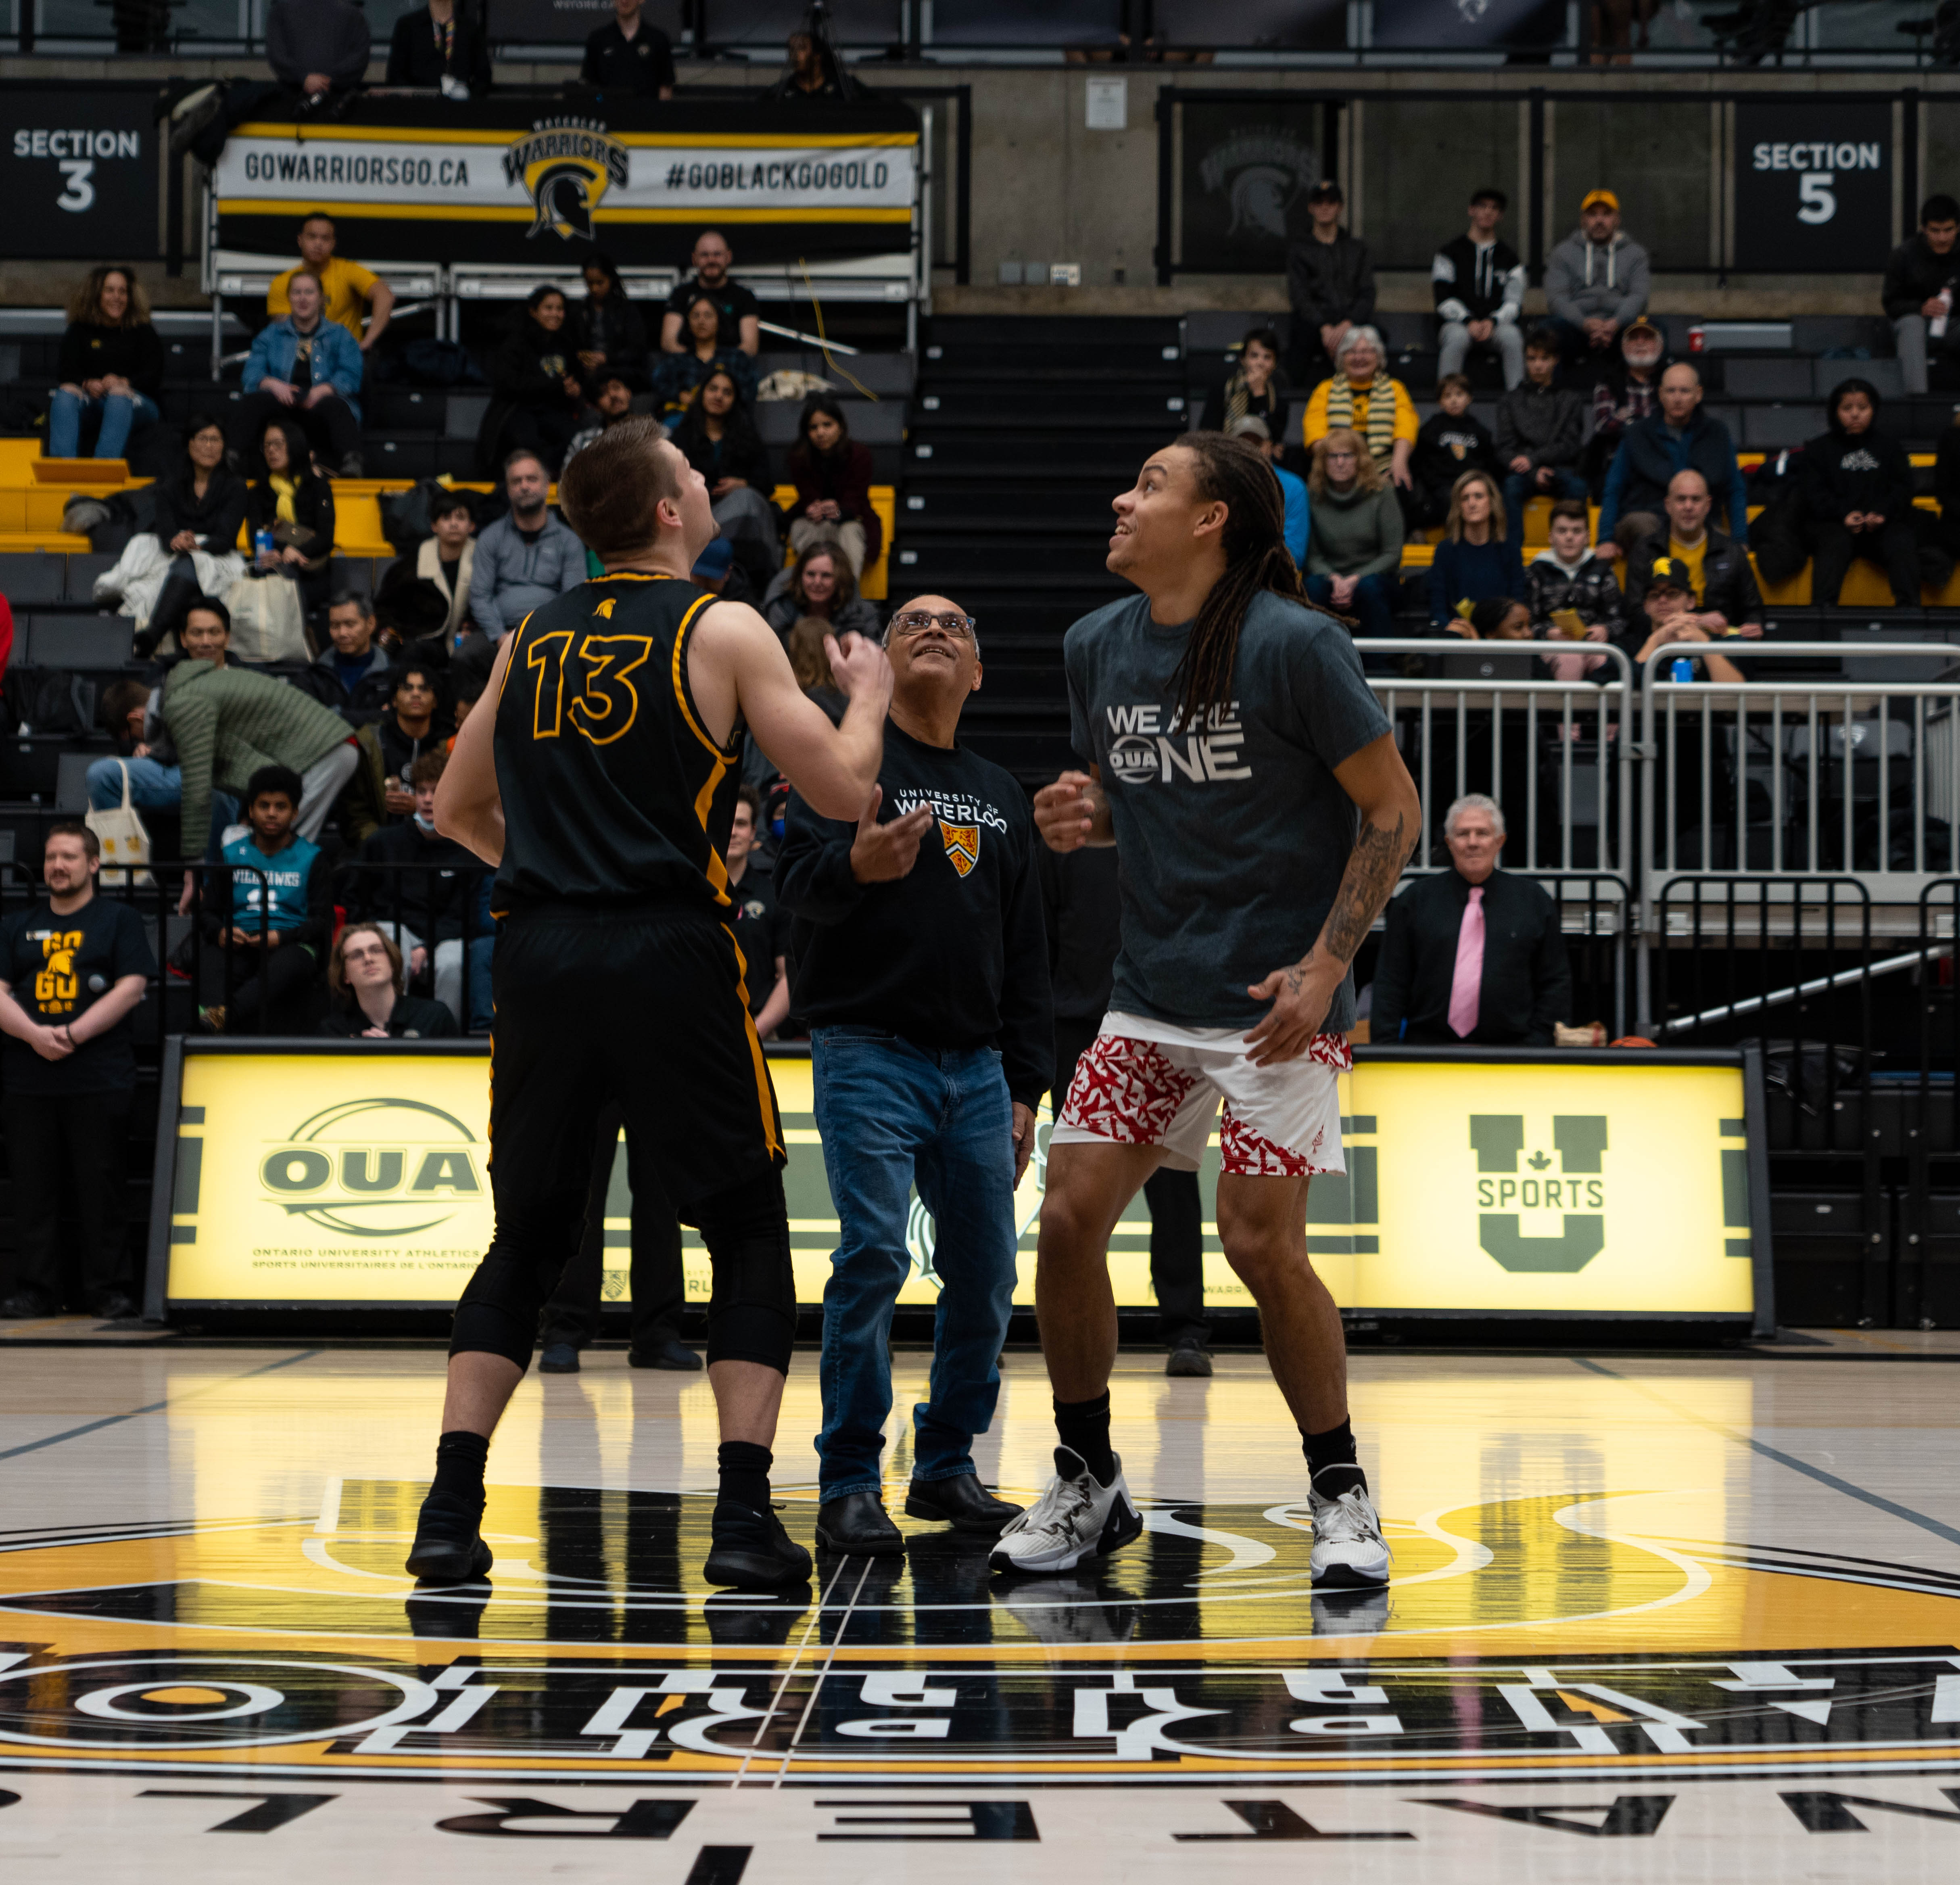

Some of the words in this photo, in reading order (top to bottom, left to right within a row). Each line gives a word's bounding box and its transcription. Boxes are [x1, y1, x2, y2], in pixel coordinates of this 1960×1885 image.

[14, 129, 140, 159] SECTION
[1752, 142, 1881, 171] SECTION
[245, 153, 468, 187] GOWARRIORSGO.CA
[502, 134, 628, 187] WARRIORS
[666, 161, 888, 190] #GOBLACKGOGOLD
[56, 159, 97, 213] 3
[1796, 171, 1837, 225] 5
[526, 629, 653, 746] 13
[1106, 704, 1161, 734] WE
[1167, 700, 1242, 733] ARE
[1109, 750, 1158, 769] OUA
[899, 788, 981, 807] UNIVERSITY
[986, 803, 999, 815] OF
[42, 930, 83, 959] GO
[35, 970, 77, 1001] GO
[259, 1147, 484, 1196] OUA
[1478, 1179, 1604, 1208] SPORTS
[252, 1261, 297, 1269] SPORTS
[301, 1261, 396, 1269] UNIVERSITAIRES
[400, 1261, 415, 1270] DE
[253, 1248, 313, 1257] ONTARIO
[318, 1248, 400, 1258] UNIVERSITY
[405, 1249, 480, 1258] ATHLETICS
